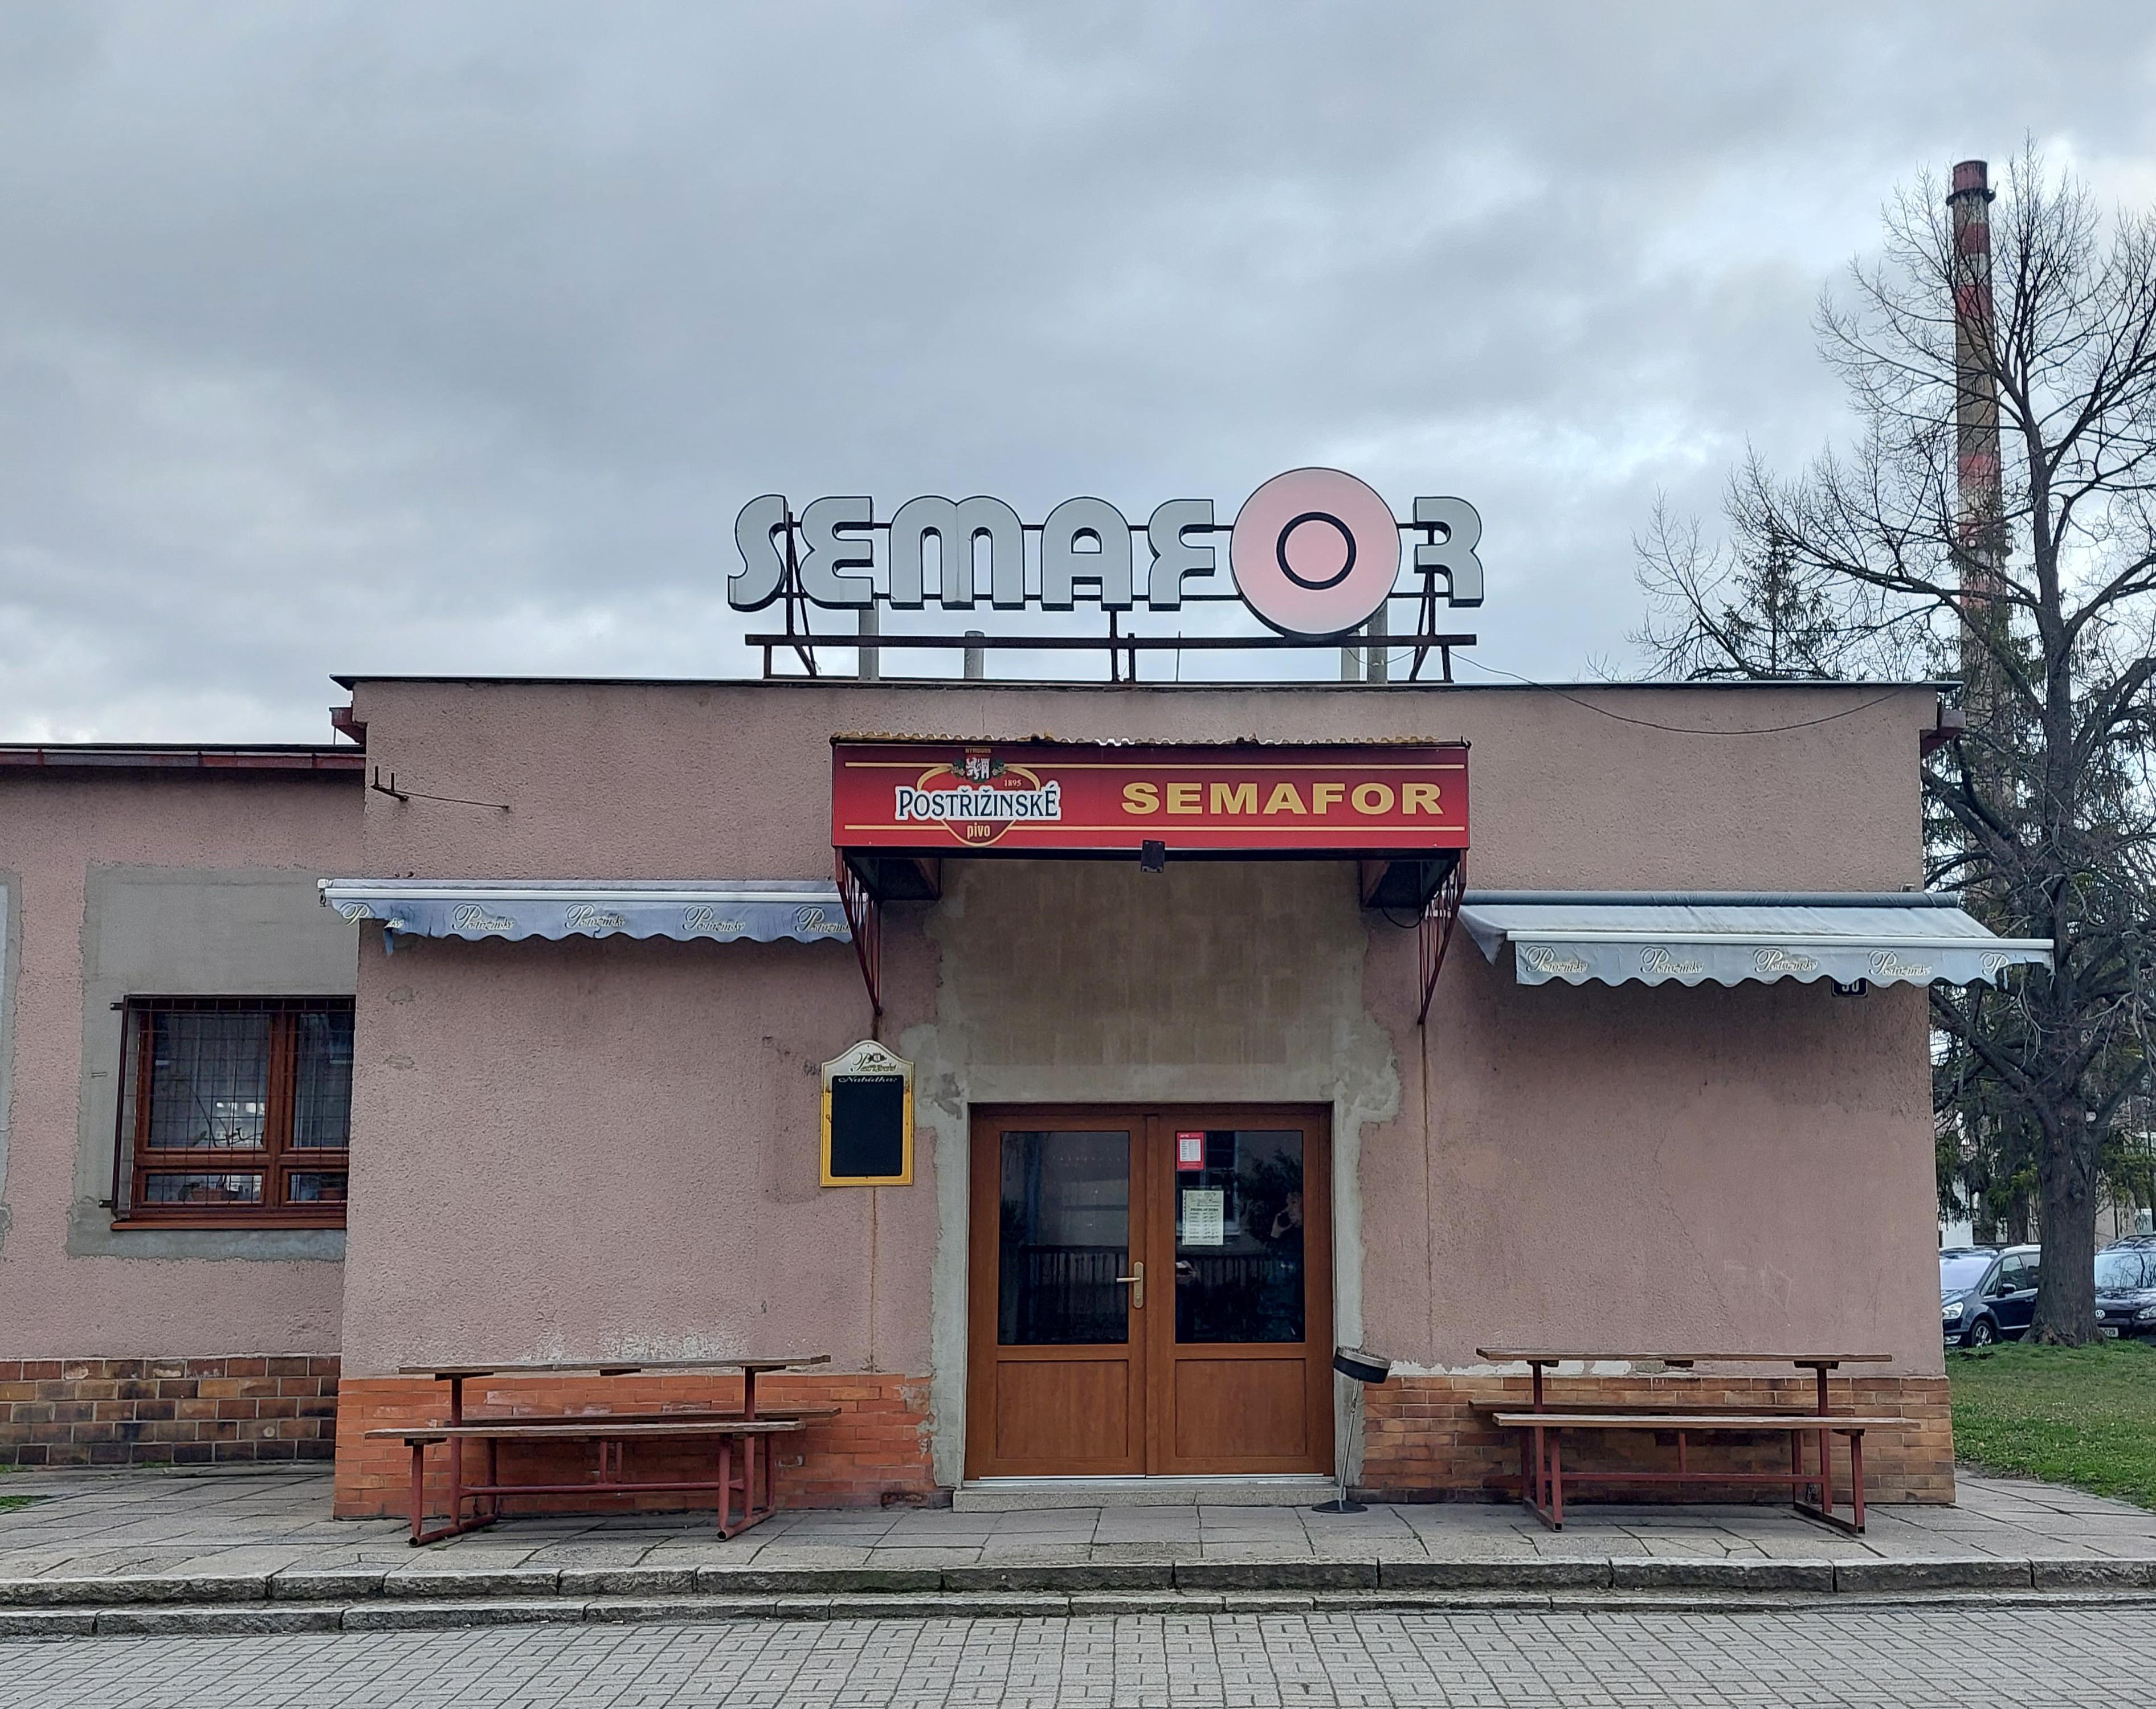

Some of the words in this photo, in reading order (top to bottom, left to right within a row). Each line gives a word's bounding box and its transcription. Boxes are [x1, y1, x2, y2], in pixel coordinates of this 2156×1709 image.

[728, 467, 1484, 637] SEMAFOR
[899, 784, 1057, 817] POSTŘIŽINSKÉ
[1121, 783, 1444, 815] SEMAFOR
[967, 822, 990, 839] pivo
